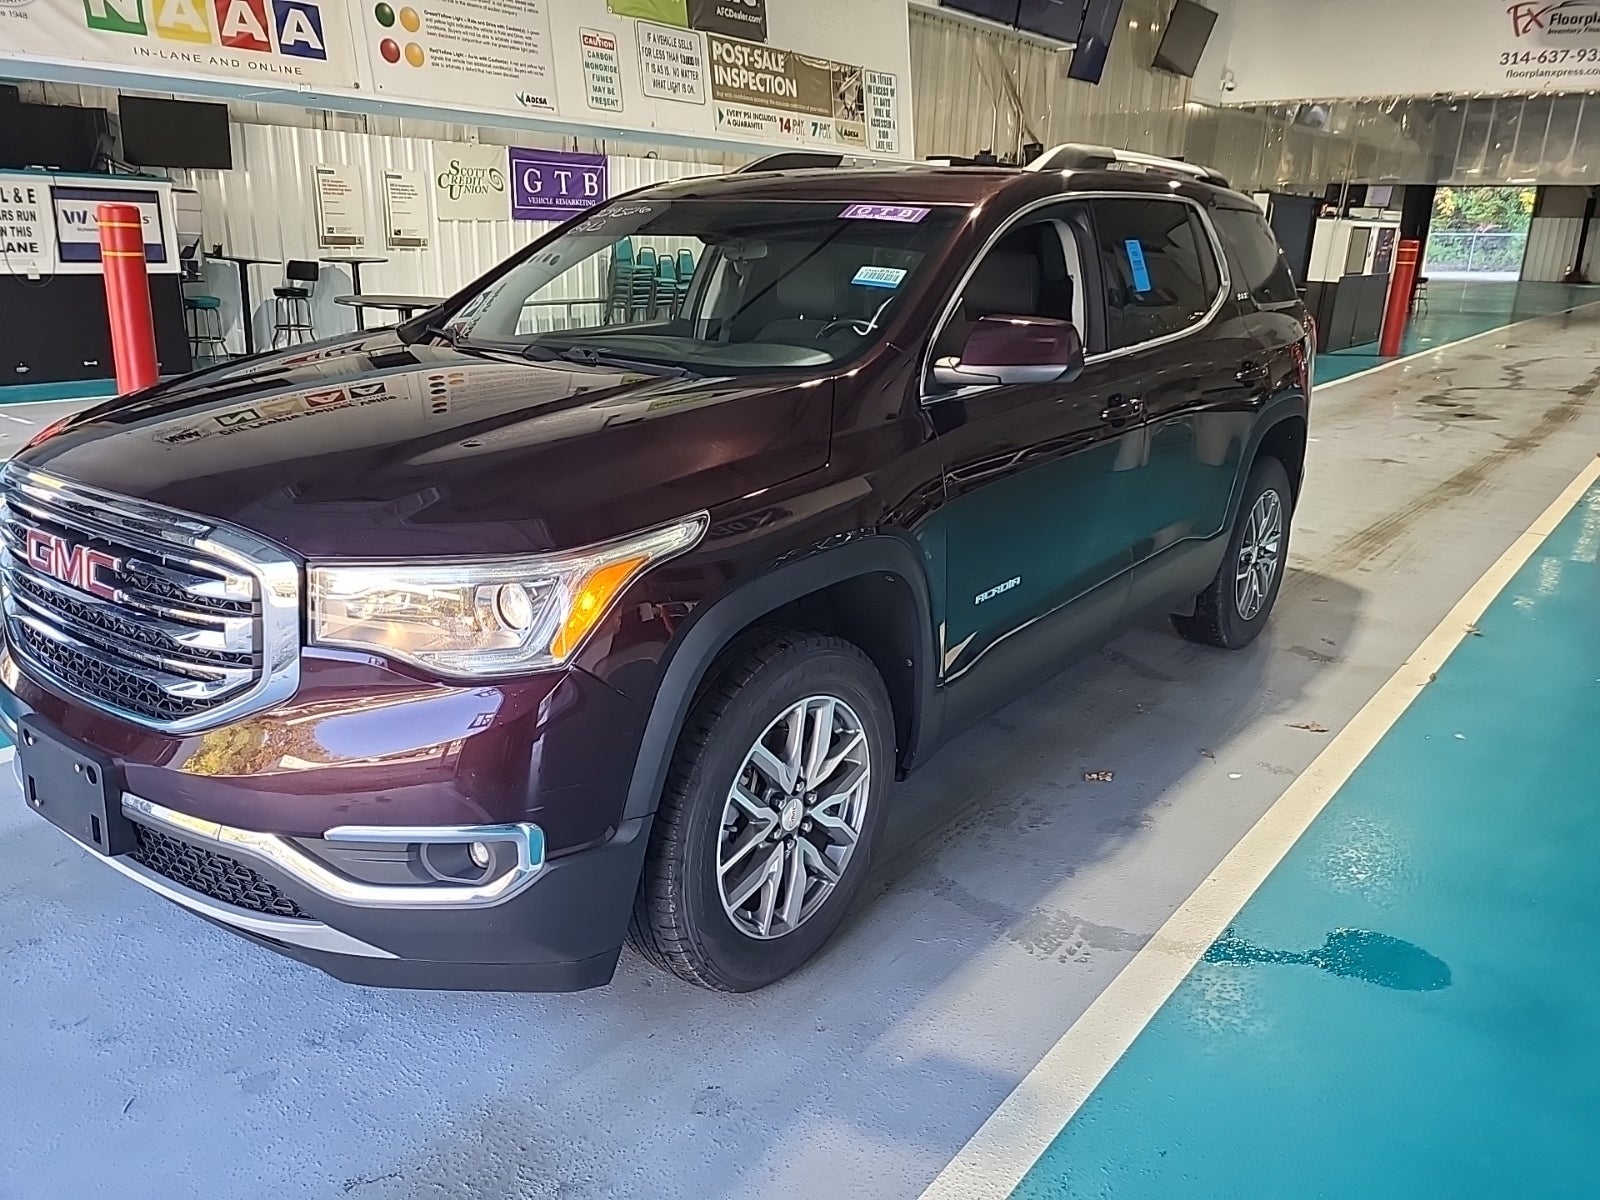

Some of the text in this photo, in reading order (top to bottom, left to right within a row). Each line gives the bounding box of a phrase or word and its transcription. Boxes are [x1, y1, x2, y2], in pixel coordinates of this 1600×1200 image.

[9, 10, 28, 20] 1948
[716, 6, 762, 24] AFCDealer.com
[583, 37, 614, 49] CAUTION
[657, 34, 678, 48] VEHICLE
[678, 38, 693, 51] SELLS
[587, 50, 613, 61] CARBON
[641, 46, 652, 59] FOR
[653, 48, 666, 60] LESS
[666, 50, 679, 62] THAN
[712, 40, 785, 73] POST-SALE
[133, 46, 303, 75] IN-LANE AND ONLINE
[584, 61, 618, 74] MONOXIDE
[592, 73, 613, 84] FUMES
[681, 69, 699, 81] MATTER
[713, 64, 798, 97] INSPECTION
[592, 85, 616, 96] MAY BE
[652, 78, 666, 90] WHAT
[667, 80, 681, 94] LIGHT
[591, 96, 619, 107] PRESENT
[726, 108, 742, 118] EVERY
[732, 119, 763, 130] GUARANTEE
[779, 117, 791, 133] 14
[792, 119, 805, 127] DAY
[811, 121, 818, 137] 7
[820, 122, 831, 131] DAY
[13, 187, 23, 203] &
[27, 188, 36, 204] E
[528, 196, 596, 207] VEHICLE REMARKETING
[0, 210, 37, 222] RS RUN
[9, 226, 32, 237] THIS
[27, 528, 122, 604] GMC
[975, 576, 1021, 605] ACADIA
